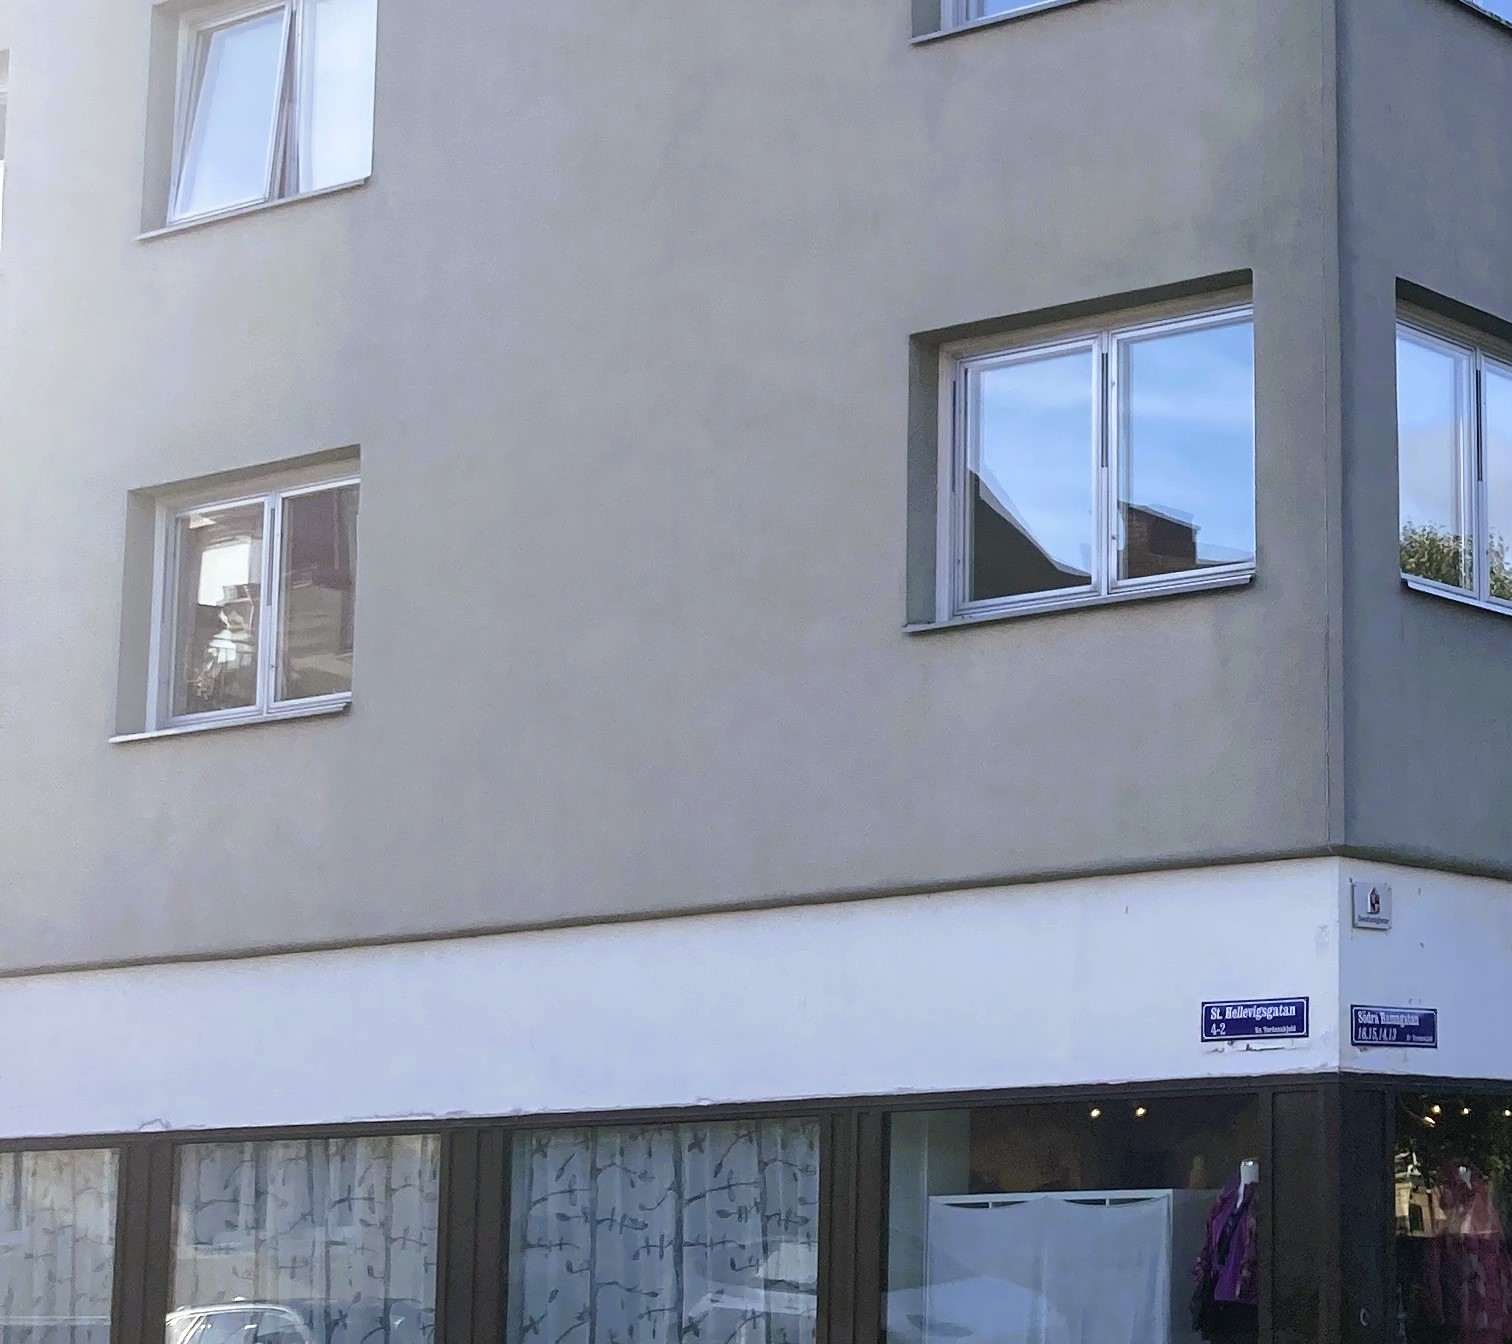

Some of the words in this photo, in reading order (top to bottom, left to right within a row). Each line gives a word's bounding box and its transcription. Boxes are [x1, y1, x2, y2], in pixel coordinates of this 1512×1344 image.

[1210, 1007, 1223, 1020] St.
[1225, 1004, 1296, 1020] Hellevigsgatan
[1210, 1022, 1226, 1035] 4-2
